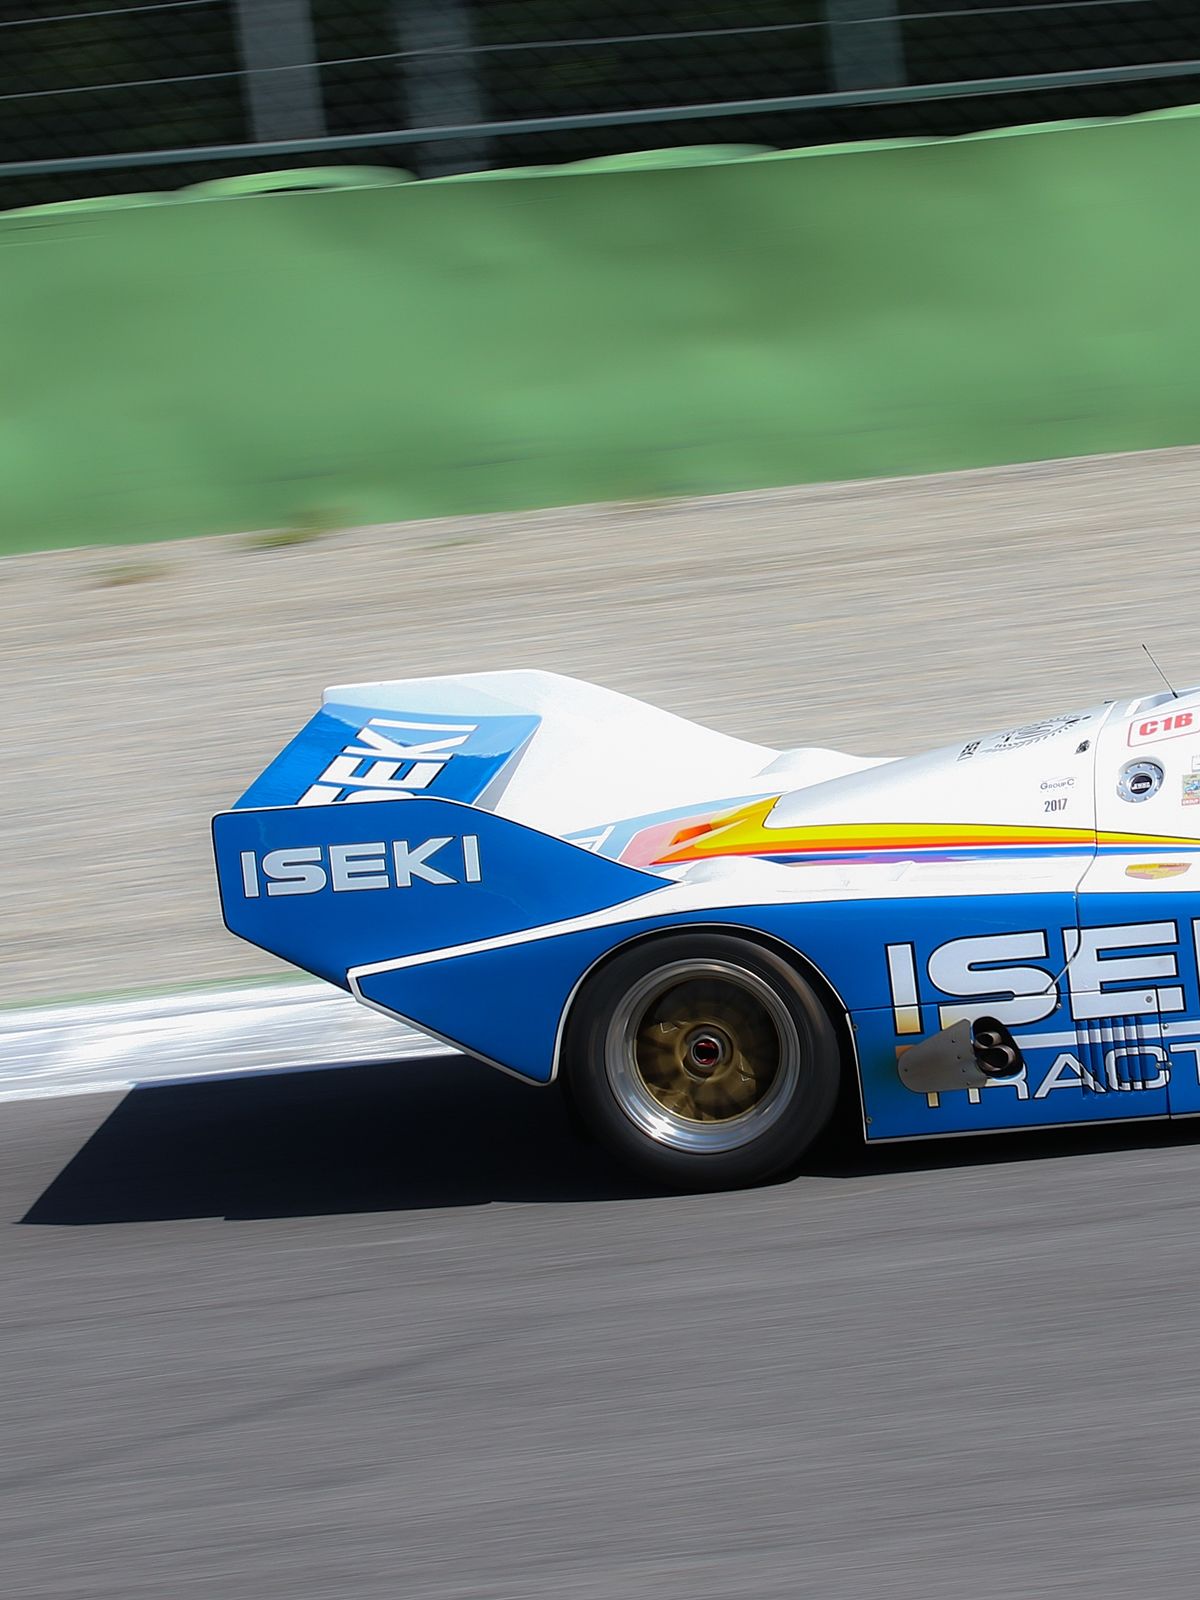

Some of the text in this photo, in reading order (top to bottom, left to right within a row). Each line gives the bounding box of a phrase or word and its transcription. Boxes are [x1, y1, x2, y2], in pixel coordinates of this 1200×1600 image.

[1138, 712, 1193, 736] C1B
[1044, 798, 1068, 813] 2017
[240, 834, 482, 899] ISEKI
